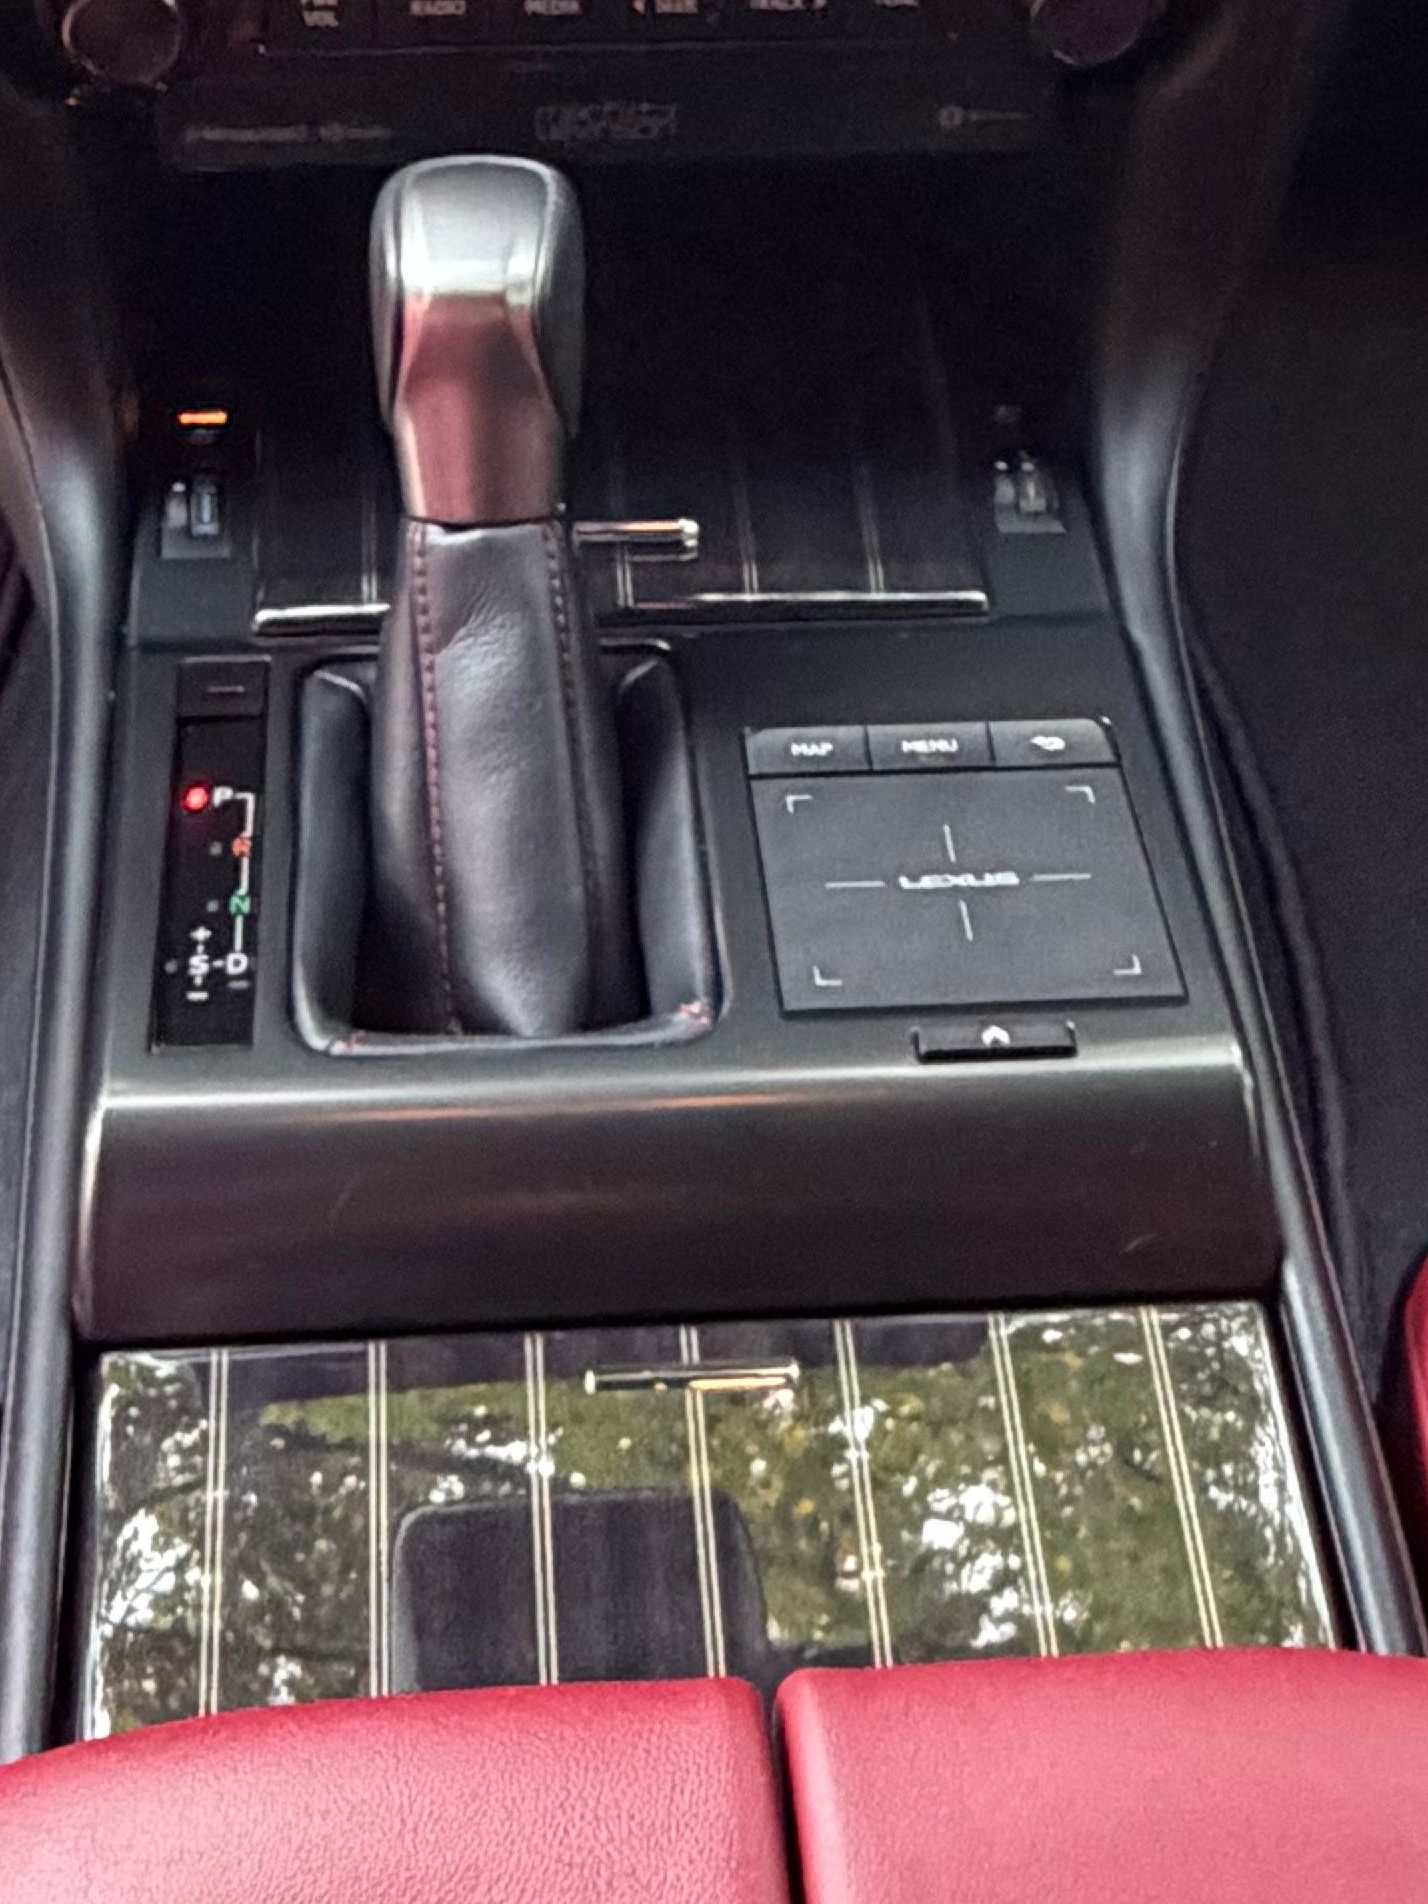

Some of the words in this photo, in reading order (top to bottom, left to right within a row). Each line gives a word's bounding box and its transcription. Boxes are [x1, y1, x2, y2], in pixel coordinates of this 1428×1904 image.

[790, 740, 834, 757] MAP
[901, 737, 959, 755] MENU
[212, 786, 234, 807] P
[897, 871, 1021, 891] LEXUS
[229, 894, 251, 915] N
[226, 951, 249, 974] D
